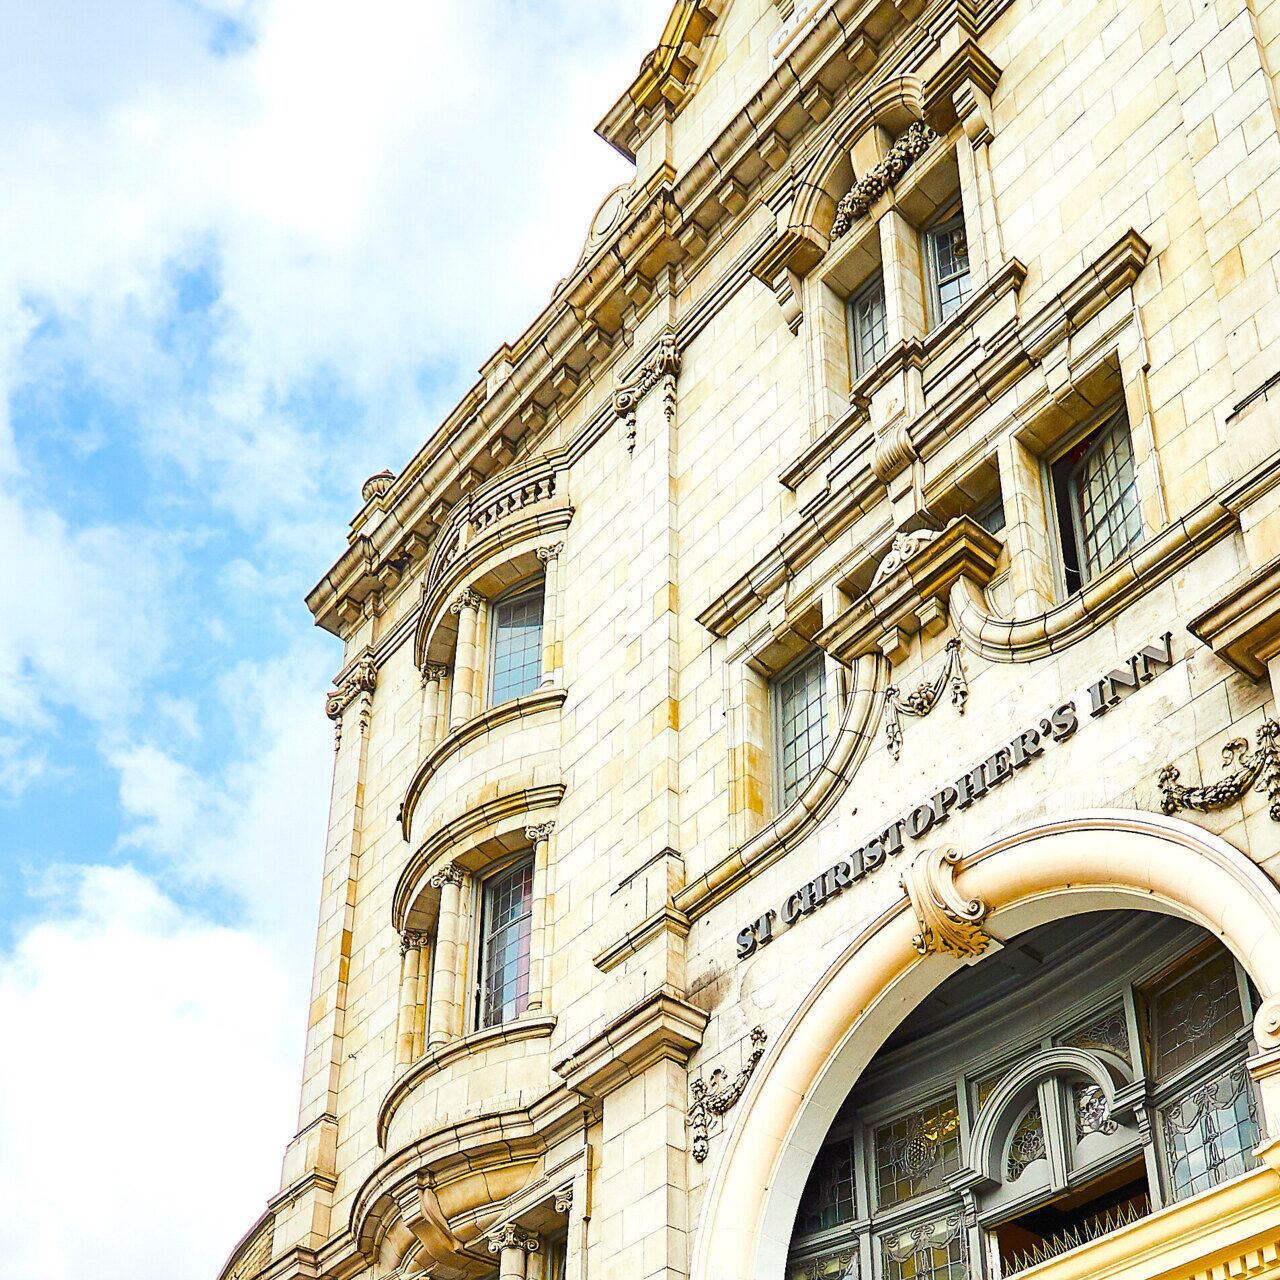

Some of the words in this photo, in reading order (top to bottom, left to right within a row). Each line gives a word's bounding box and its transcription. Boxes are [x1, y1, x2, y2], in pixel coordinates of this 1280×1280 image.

[736, 909, 776, 959] ST
[780, 701, 1078, 925] CHRISTOPHER'S
[1087, 631, 1175, 718] INN
